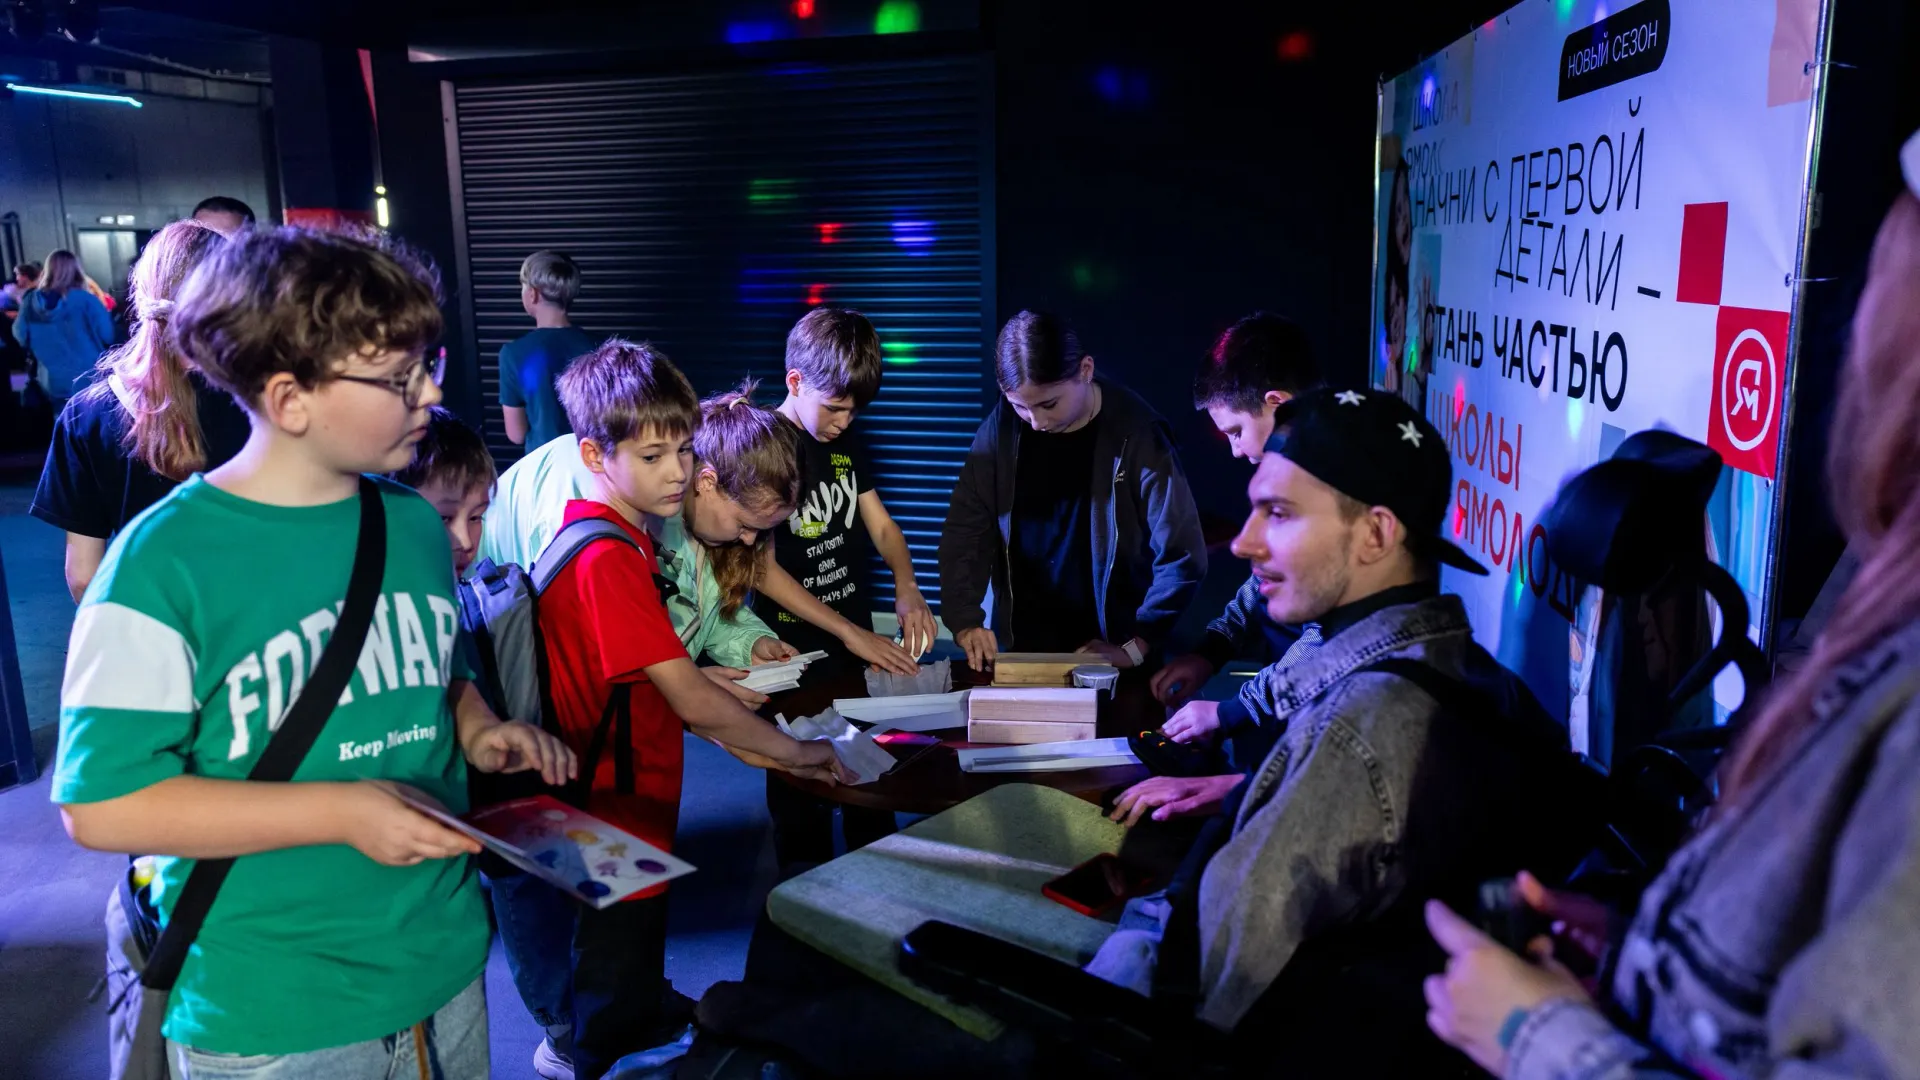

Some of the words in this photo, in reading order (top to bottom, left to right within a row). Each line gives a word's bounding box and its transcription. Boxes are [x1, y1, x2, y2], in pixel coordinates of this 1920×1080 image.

[1568, 31, 1609, 79] НОВЫЙ
[1612, 19, 1658, 62] СЕЗОН
[1413, 80, 1459, 131] ШКОЛА
[1412, 166, 1476, 228] НАЧНИ
[1483, 160, 1500, 223] С
[1508, 96, 1645, 219] ПЕРВОЙ
[1495, 216, 1624, 311] ДЕТАЛИ
[1424, 303, 1484, 369] СТАНЬ
[1493, 314, 1628, 412] ЧАСТЬЮ
[806, 542, 824, 558] STAY
[803, 577, 815, 588] OF
[225, 592, 459, 761] FORWAR
[338, 740, 384, 761] Keep
[386, 724, 437, 749] Moving
